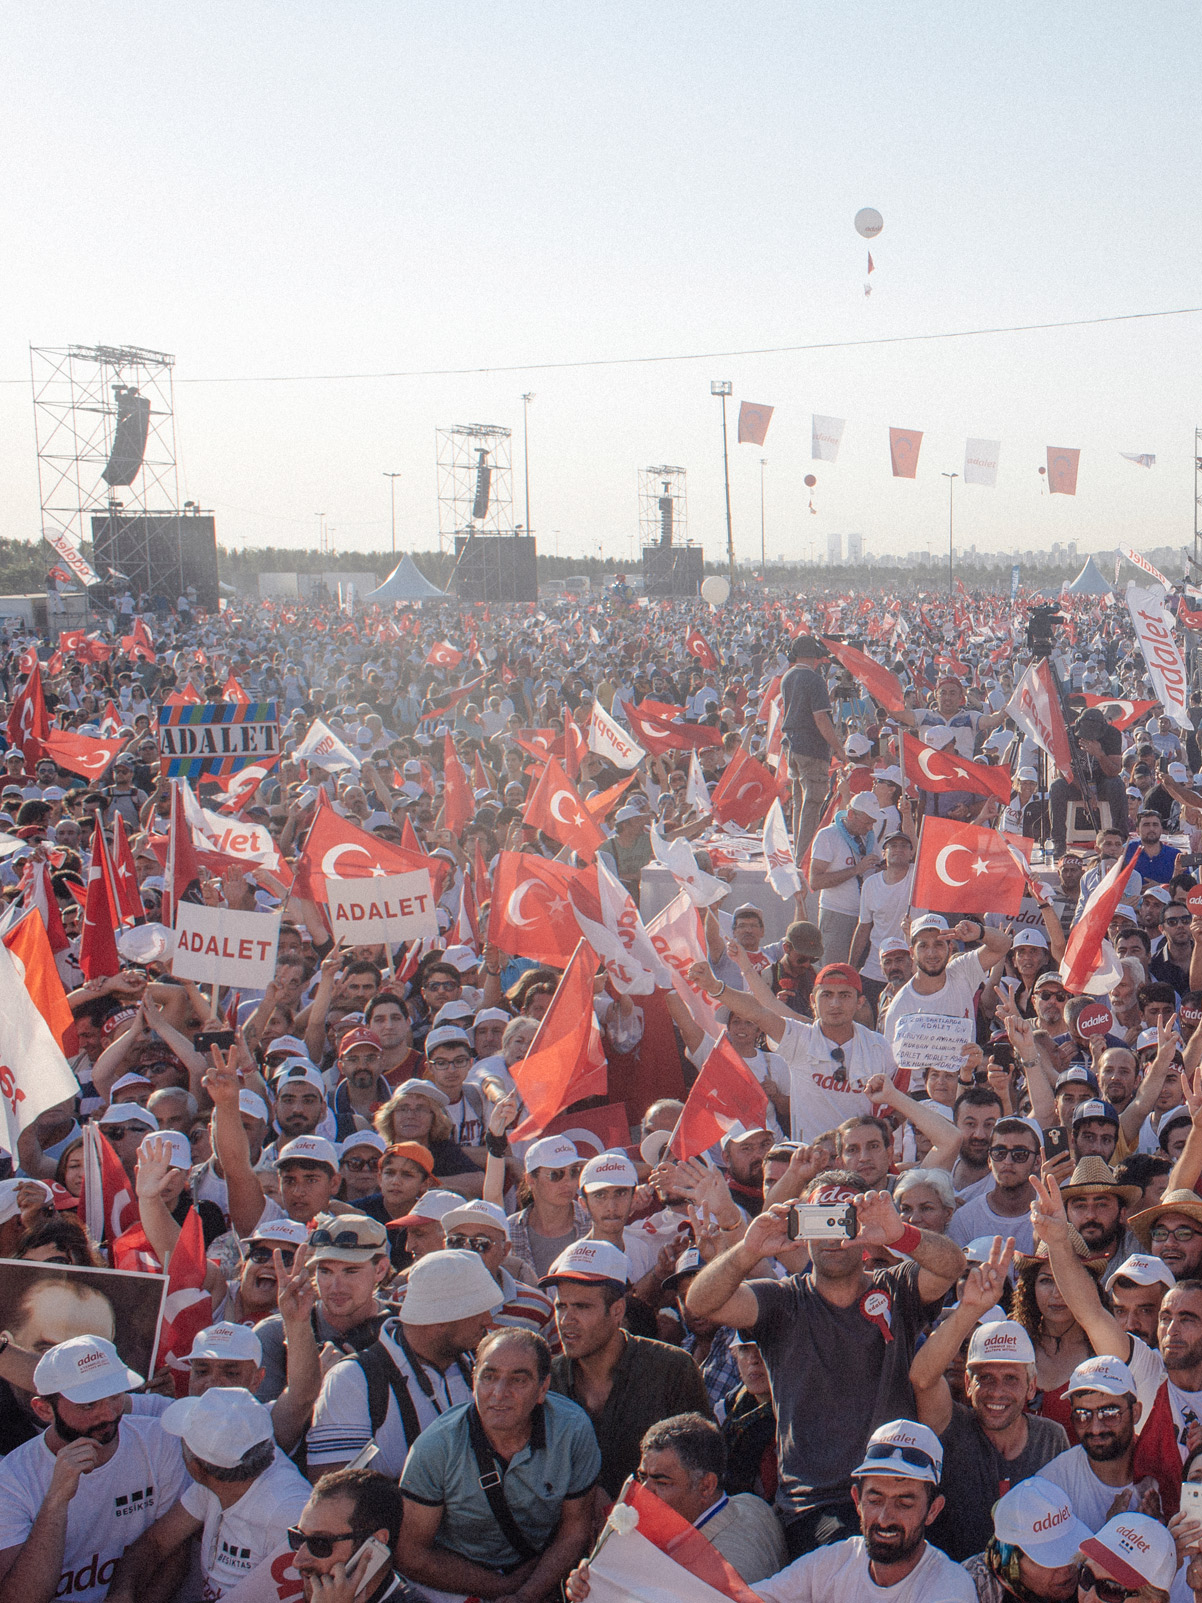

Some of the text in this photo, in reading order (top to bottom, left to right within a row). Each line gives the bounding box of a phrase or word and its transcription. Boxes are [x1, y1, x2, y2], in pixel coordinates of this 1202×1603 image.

[1136, 609, 1186, 707] adalet
[160, 725, 280, 756] ADALET
[336, 894, 429, 922] ADALET
[178, 930, 273, 962] ADALET
[1081, 1012, 1109, 1029] adalet
[596, 1163, 626, 1173] adalet
[984, 1334, 1018, 1347] adalet
[1032, 1504, 1072, 1534] adalet
[1115, 1525, 1151, 1554] adalet
